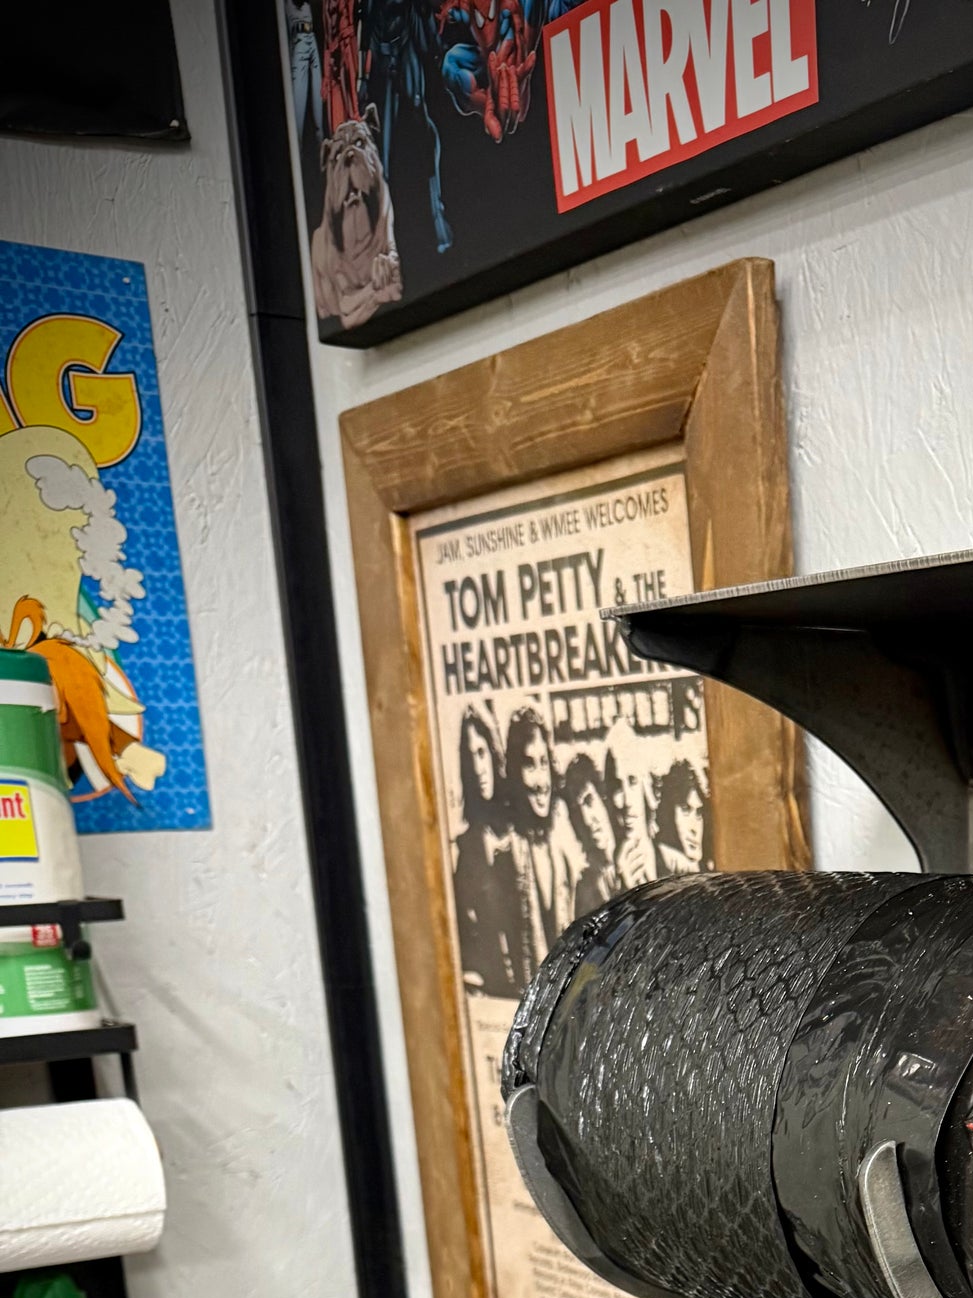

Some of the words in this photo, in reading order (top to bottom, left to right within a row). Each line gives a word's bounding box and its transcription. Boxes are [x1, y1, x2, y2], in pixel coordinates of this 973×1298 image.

[550, 0, 809, 197] MARVEL
[0, 313, 143, 470] G
[466, 523, 525, 557] SUNSHINE
[530, 521, 539, 544] &
[540, 509, 581, 540] WMEE
[584, 488, 669, 528] WELCOMES
[443, 569, 509, 632] TOM
[518, 548, 605, 620] PETTY
[615, 577, 627, 606] &
[633, 569, 667, 600] THE
[441, 621, 684, 695] HEARTBREAK
[0, 793, 25, 819] nt
